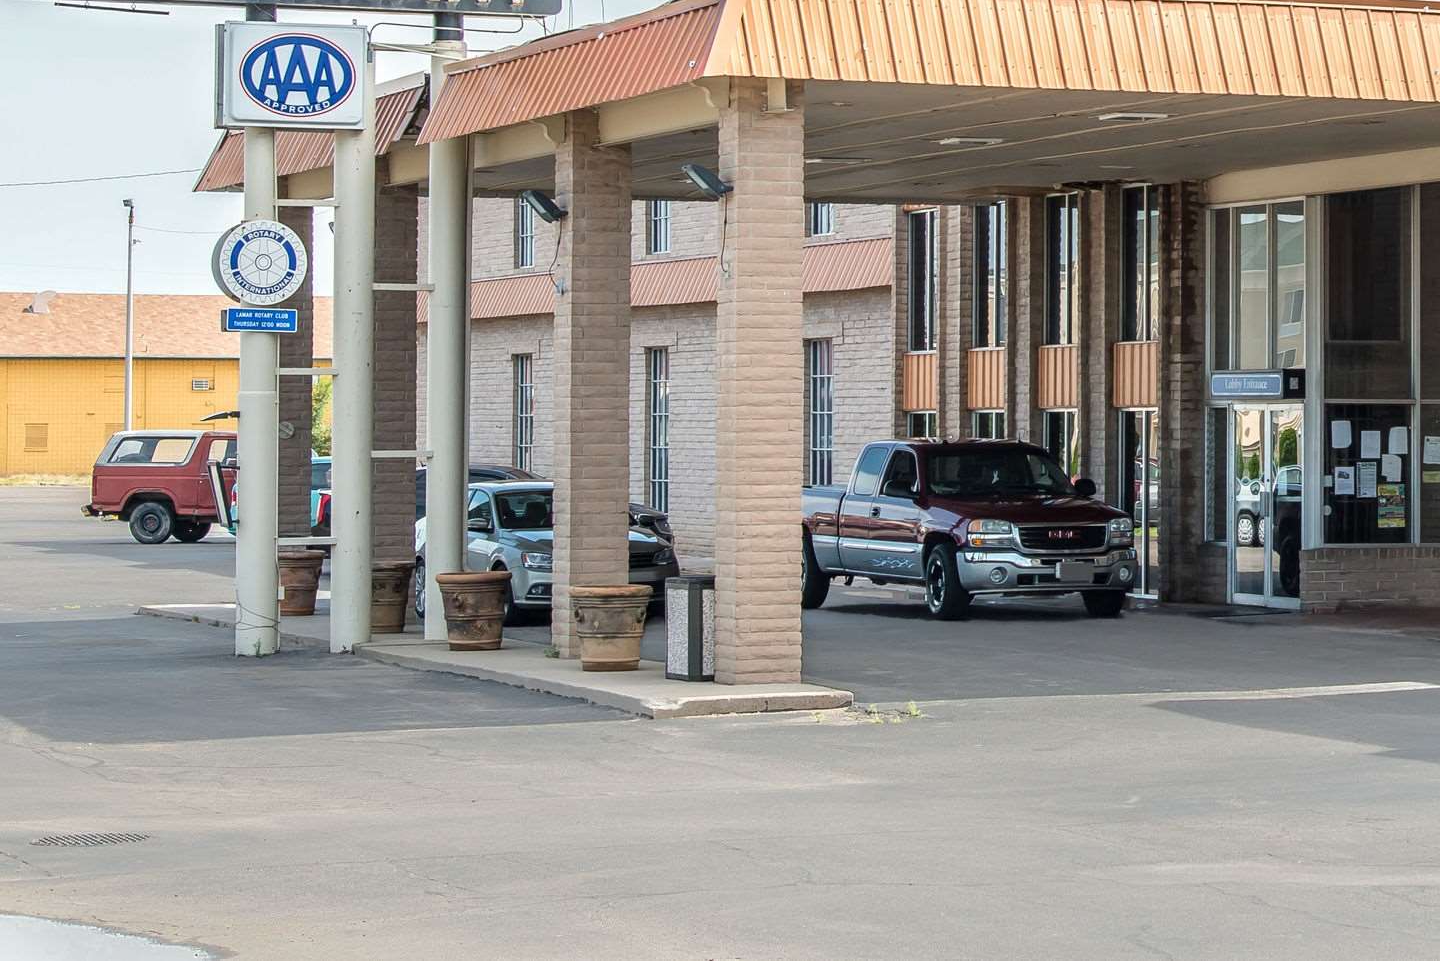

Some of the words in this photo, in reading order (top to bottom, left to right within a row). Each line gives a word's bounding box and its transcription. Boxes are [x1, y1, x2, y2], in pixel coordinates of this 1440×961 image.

[257, 43, 339, 105] AAA
[263, 99, 330, 113] APPROVED
[246, 230, 282, 240] ROTARY
[234, 273, 294, 295] INTERNATIONAL
